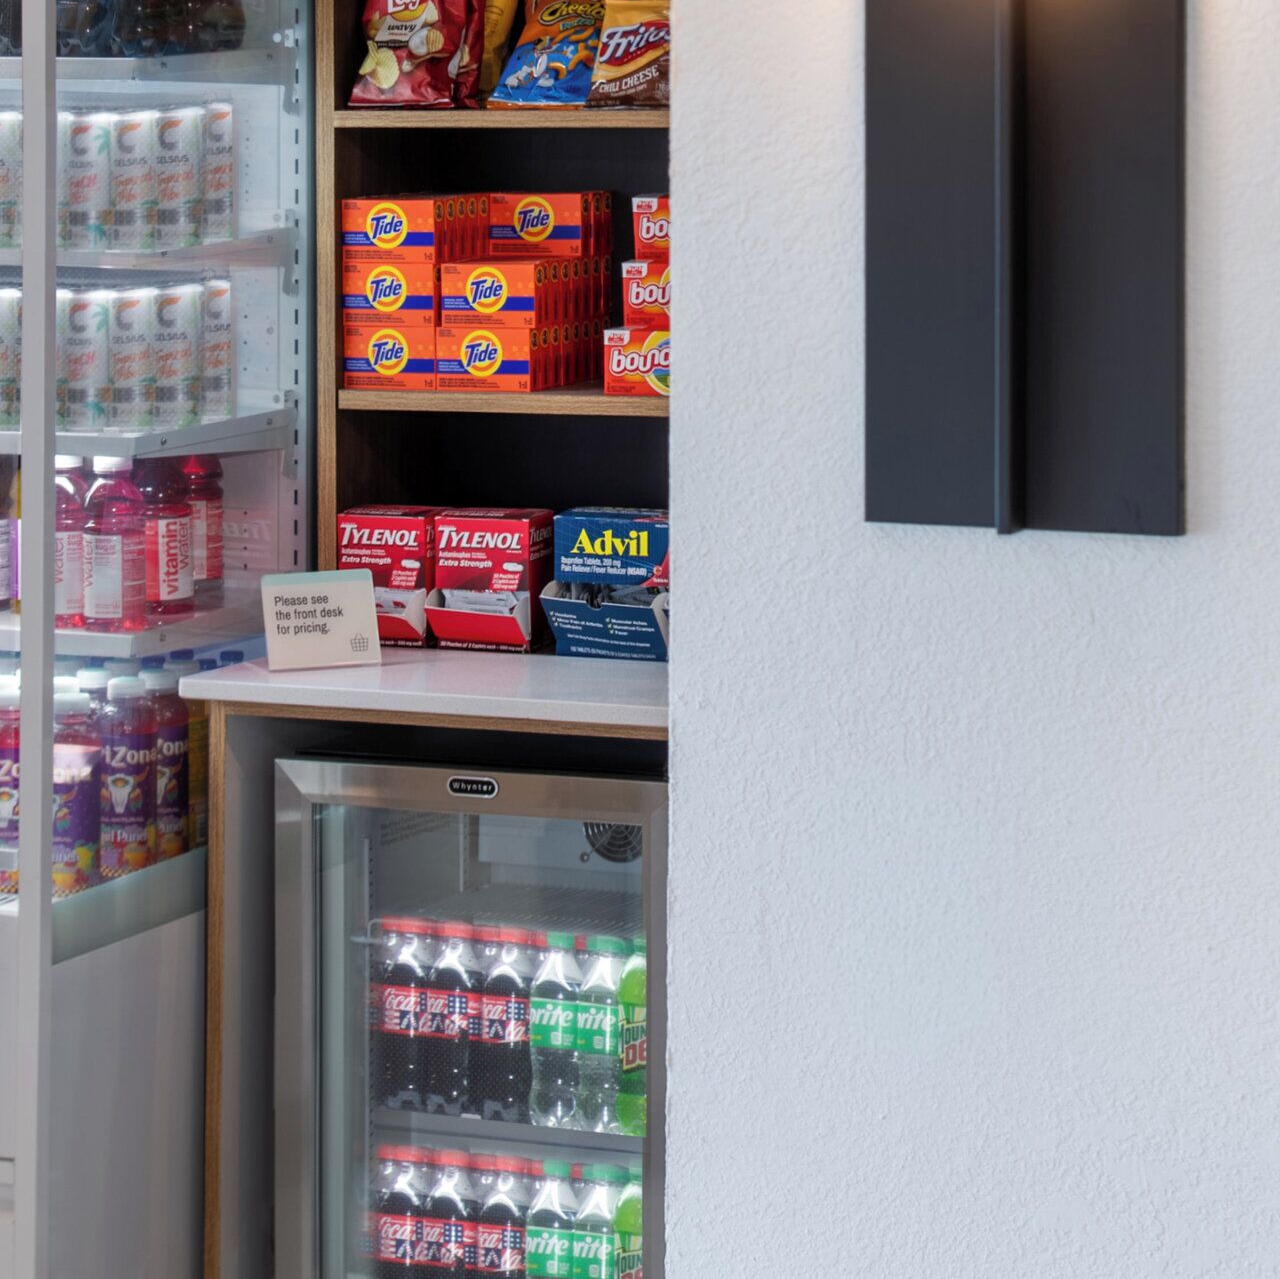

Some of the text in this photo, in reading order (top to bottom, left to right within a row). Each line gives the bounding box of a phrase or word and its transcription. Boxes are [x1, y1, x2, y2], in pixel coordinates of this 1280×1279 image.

[541, 1, 605, 22] Cheeto
[388, 24, 417, 33] wavy
[600, 78, 619, 93] CHILI
[621, 65, 659, 88] CHEESE
[370, 214, 403, 240] Tide
[518, 207, 550, 234] Tide
[370, 278, 402, 303] Tide
[469, 278, 503, 305] Tide
[372, 341, 404, 366] Tide
[465, 342, 498, 368] Tide
[178, 520, 190, 570] water
[340, 524, 419, 547] TYLENOL
[438, 525, 521, 550] TYLENOL
[570, 527, 649, 557] Advil
[163, 521, 179, 596] vitamin
[341, 555, 392, 565] Extra Strength
[439, 559, 492, 569] Extra Strength
[561, 555, 583, 565] Ibuprofen
[613, 560, 621, 568] mg
[561, 564, 571, 572] Pain
[607, 566, 626, 575] Reducer
[274, 594, 329, 607] Please see
[275, 606, 344, 621] the front desk
[277, 622, 331, 636] for pricing.
[452, 781, 493, 792] Whynter
